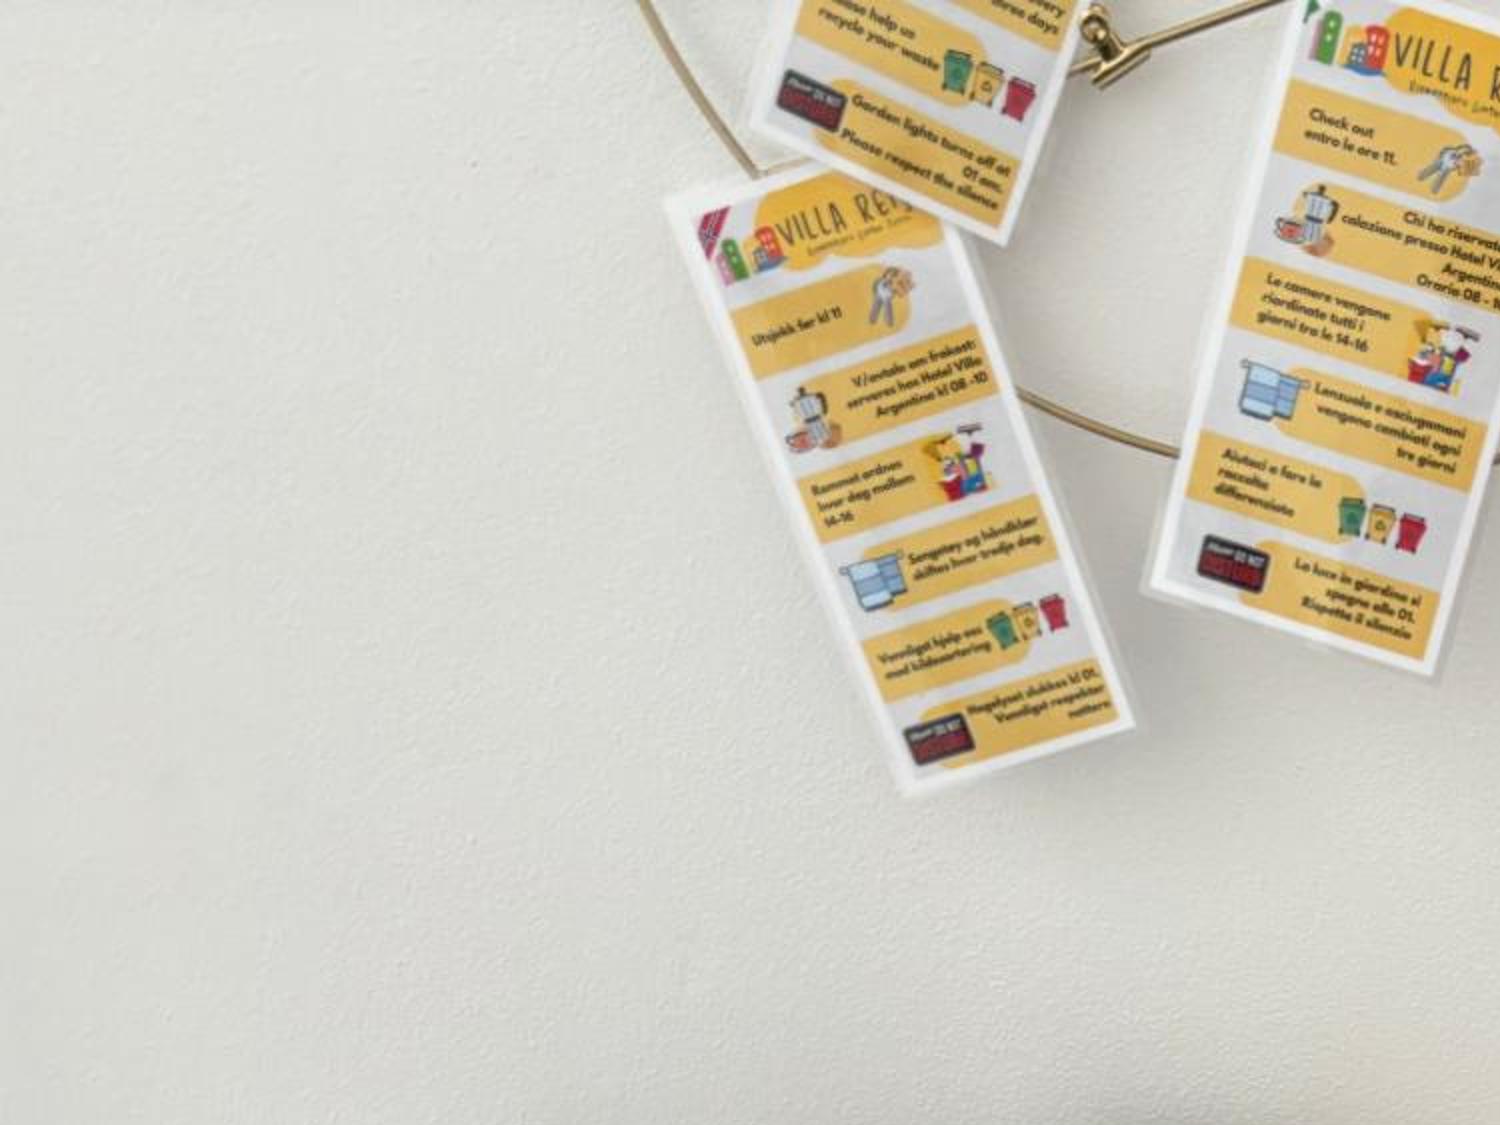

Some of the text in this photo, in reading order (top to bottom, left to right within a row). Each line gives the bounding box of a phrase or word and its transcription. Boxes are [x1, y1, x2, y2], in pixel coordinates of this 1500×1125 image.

[818, 8, 865, 35] recycle
[866, 32, 900, 50] your
[869, 6, 898, 31] help
[899, 27, 916, 39] us
[1027, 11, 1057, 34] days
[1394, 32, 1473, 90] VILLA
[852, 94, 901, 125] Garden
[903, 117, 939, 143] lights
[976, 156, 997, 169] off
[995, 165, 1011, 177] at
[1309, 108, 1375, 139] Check out
[1304, 130, 1341, 148] entro
[1343, 137, 1355, 152] le
[1356, 146, 1380, 160] ore
[840, 128, 999, 210] Please respect the silence
[775, 202, 847, 246] VILLA
[1403, 211, 1426, 227] Chi
[1427, 219, 1446, 234] ha
[1341, 214, 1403, 240] colazione
[1404, 235, 1448, 255] presso
[1450, 245, 1486, 266] Hotel
[1266, 272, 1391, 321] Le camere vengono
[1417, 274, 1461, 298] Orario
[1463, 288, 1481, 303] 08
[1257, 310, 1297, 330] giorni
[1320, 327, 1333, 342] le
[1329, 313, 1358, 330] tutti
[920, 363, 953, 384] Hotel
[953, 356, 983, 372] Villa
[876, 391, 936, 418] Argentina
[1317, 405, 1462, 457] vengono cambiati ogni
[1221, 448, 1267, 471] Aiutaci
[1280, 465, 1307, 484] fare
[1309, 474, 1322, 488] la
[1397, 447, 1456, 474] tre giorni
[1294, 557, 1311, 572] La
[1312, 563, 1338, 580] luce
[1339, 572, 1353, 585] in
[1354, 579, 1408, 603] giardino
[1325, 589, 1371, 609] spegne
